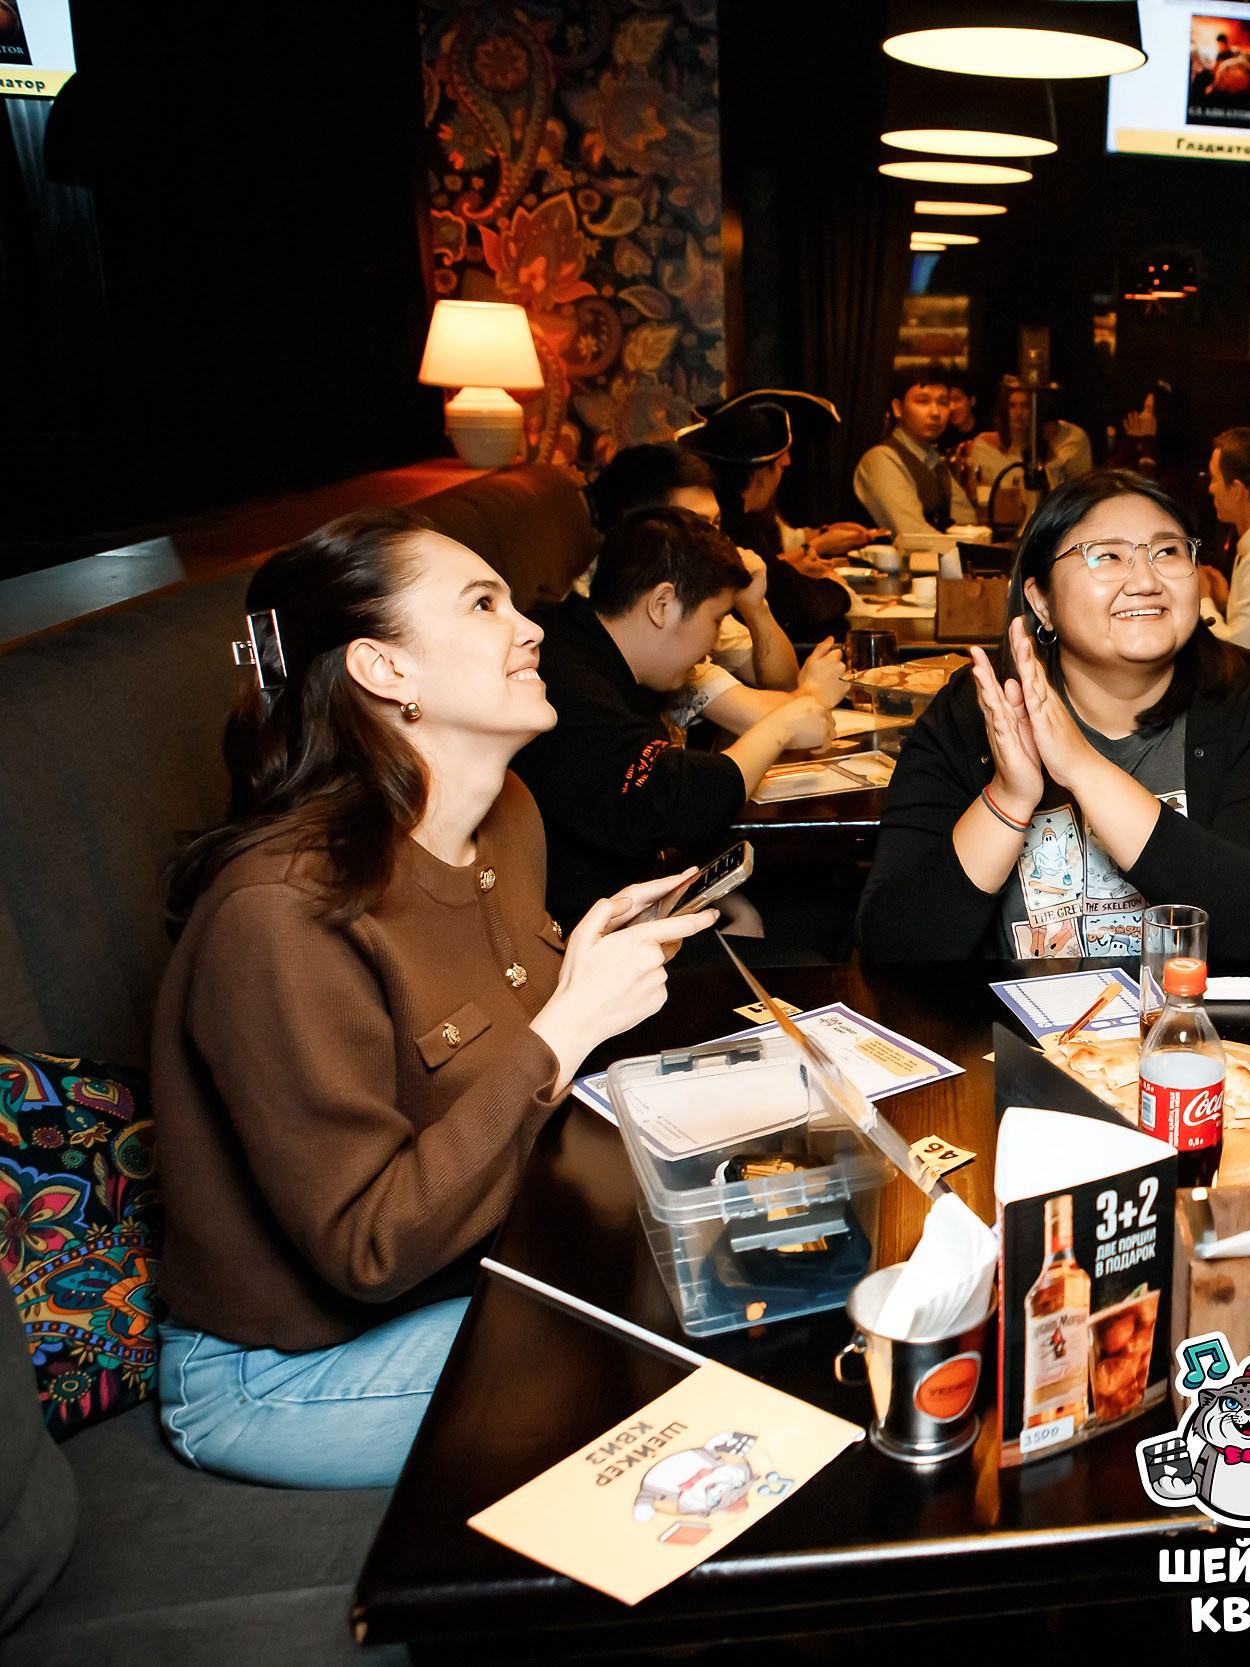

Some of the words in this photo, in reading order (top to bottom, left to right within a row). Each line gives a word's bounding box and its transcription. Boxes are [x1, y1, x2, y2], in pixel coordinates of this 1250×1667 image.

[1032, 910, 1056, 924] THE
[1086, 902, 1099, 912] THE
[1102, 898, 1141, 911] SKELETON
[1096, 1176, 1159, 1240] 3+2
[1095, 1240, 1118, 1261] ДВЕ
[1118, 1226, 1157, 1253] ПОРЦИИ
[1095, 1260, 1104, 1278] В
[1105, 1241, 1156, 1275] ПОДАРОК
[585, 1421, 654, 1465] КВИЗ
[595, 1421, 688, 1487] ШЕЙКЕР
[1024, 1427, 1059, 1447] 3500
